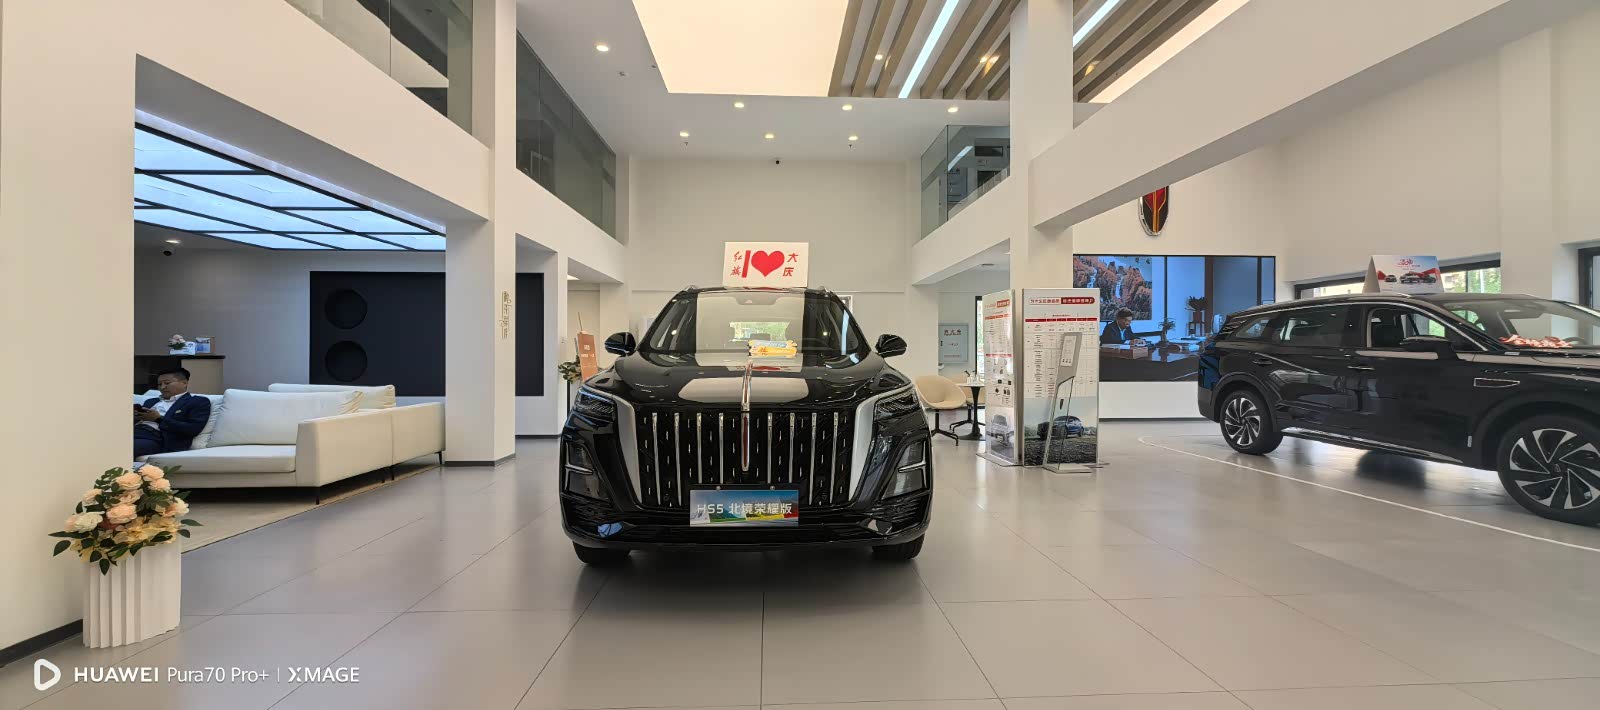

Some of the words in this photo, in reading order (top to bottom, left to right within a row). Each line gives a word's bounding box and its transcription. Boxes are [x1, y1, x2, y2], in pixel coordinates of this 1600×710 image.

[730, 251, 742, 276] 红旗
[782, 252, 799, 277] 大庆
[697, 503, 724, 514] HS5
[728, 503, 792, 515] 北境荣耀版
